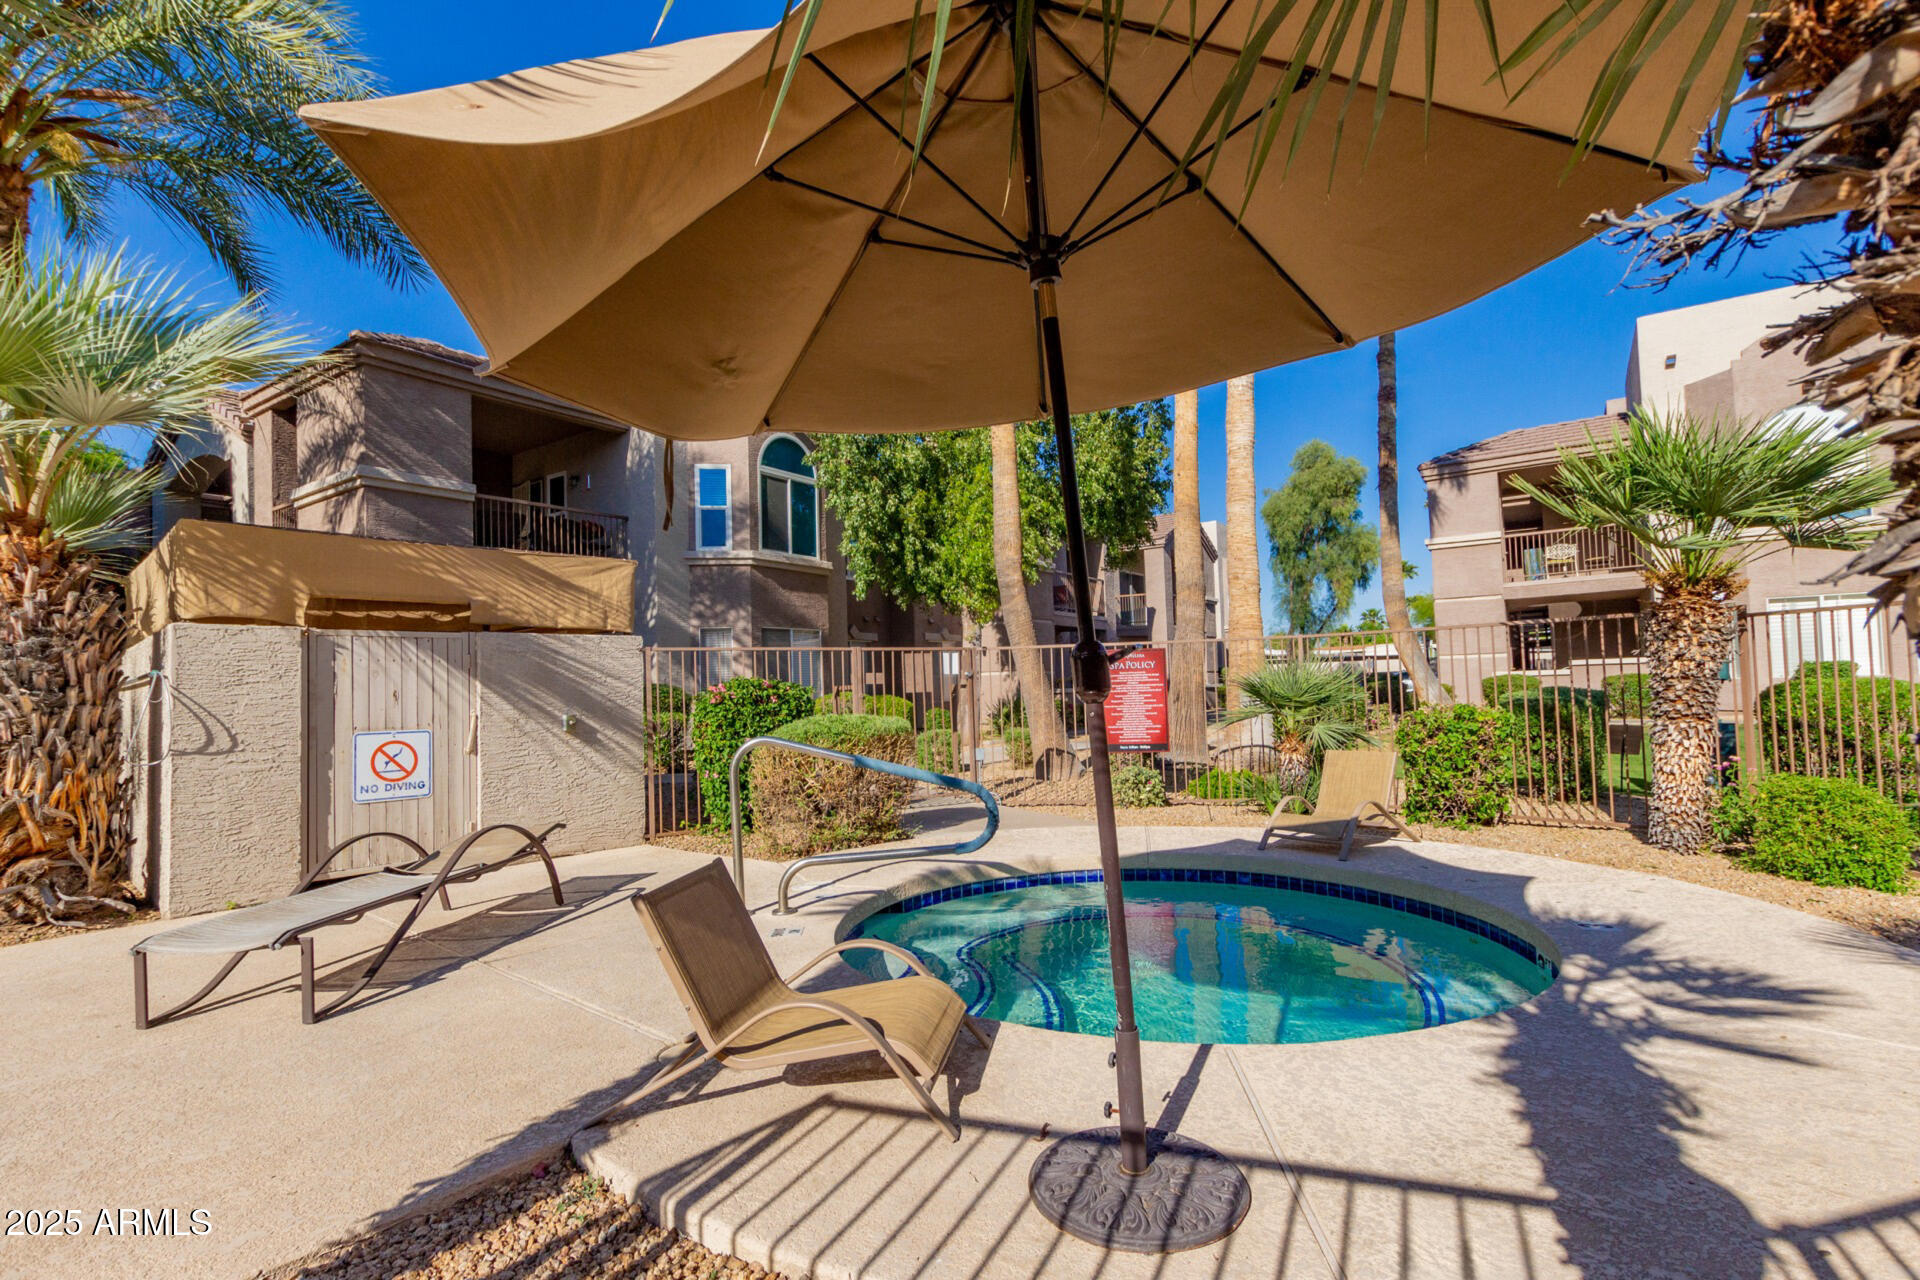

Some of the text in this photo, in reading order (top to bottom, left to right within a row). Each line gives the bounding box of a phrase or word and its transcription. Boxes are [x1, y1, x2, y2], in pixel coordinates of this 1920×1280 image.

[1125, 660, 1156, 669] POLICY
[360, 780, 426, 794] NO DIVING
